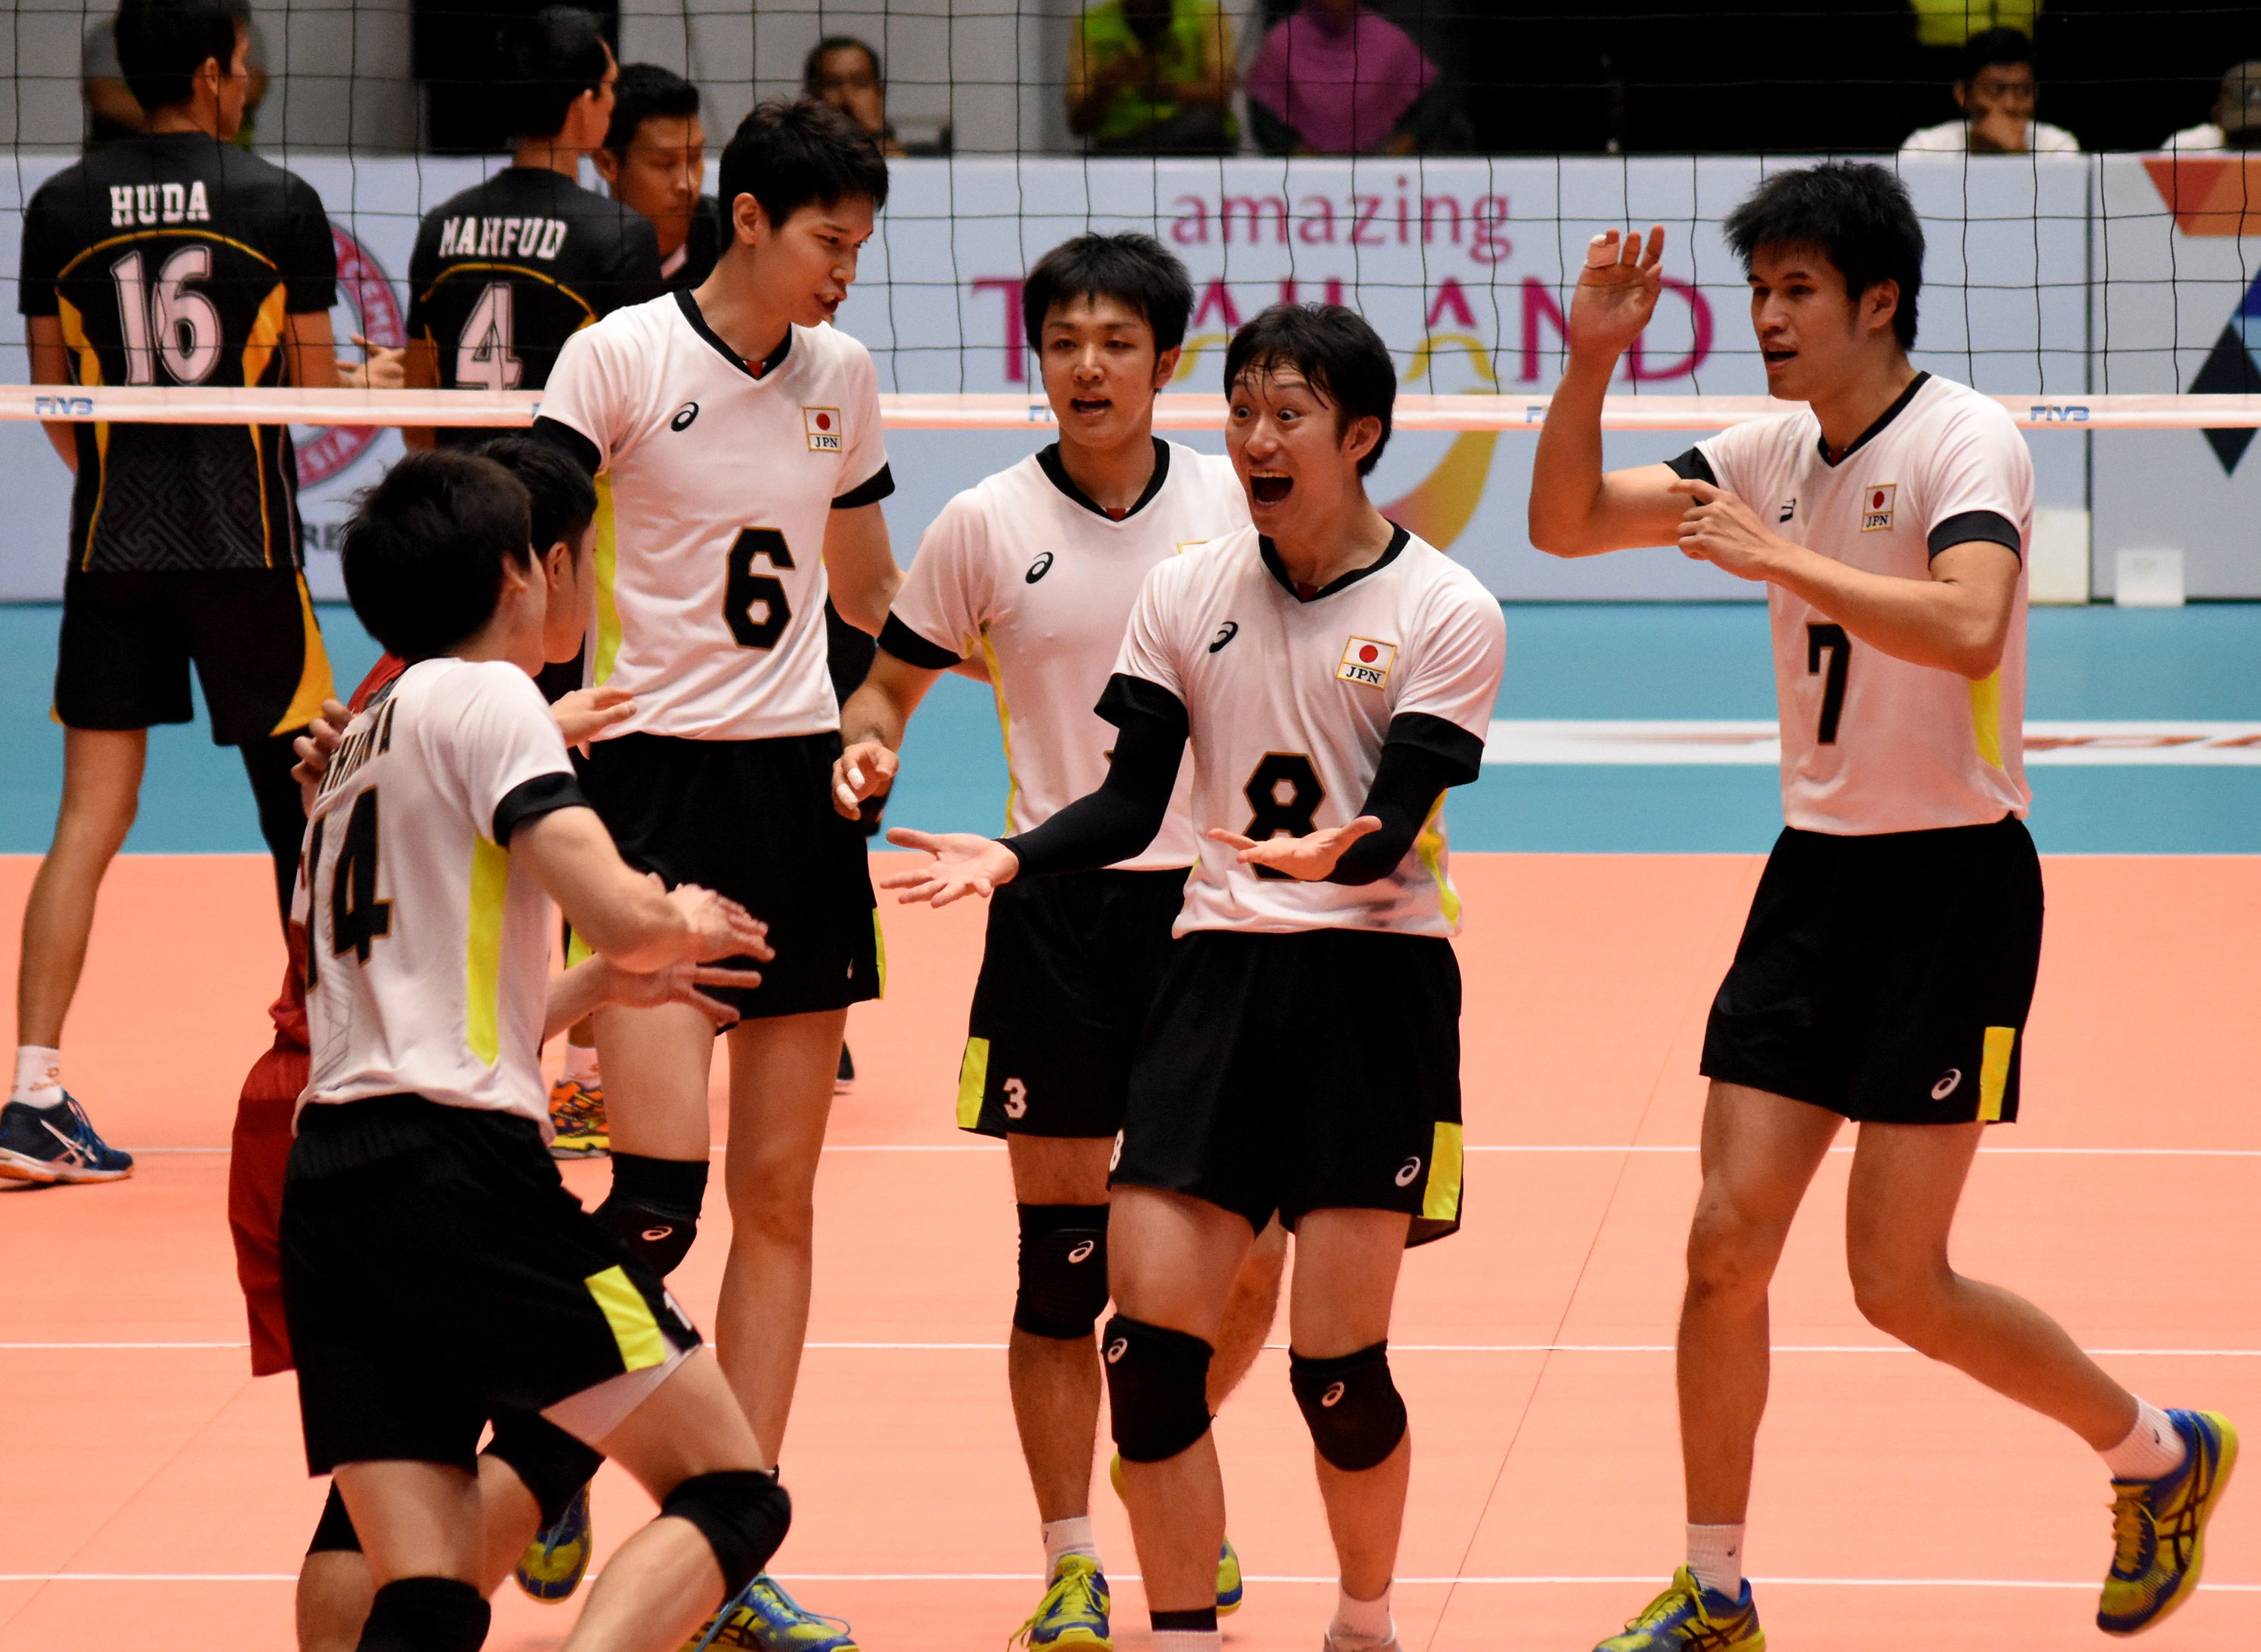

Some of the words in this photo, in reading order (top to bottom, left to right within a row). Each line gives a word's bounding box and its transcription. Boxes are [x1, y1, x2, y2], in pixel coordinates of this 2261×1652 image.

[109, 180, 211, 227] HUDA
[1170, 175, 1513, 264] amazing
[109, 245, 222, 387] 16
[455, 282, 523, 391] 4
[971, 277, 1712, 381] TAAND
[815, 436, 838, 448] JPN
[1866, 515, 1889, 528] JPN
[721, 525, 796, 650] 6
[1346, 666, 1381, 684] JPN
[1807, 621, 1853, 746] 7
[1242, 751, 1326, 883] 8
[306, 785, 393, 995] 14
[1003, 1077, 1028, 1120] 3
[1109, 1129, 1124, 1172] 8
